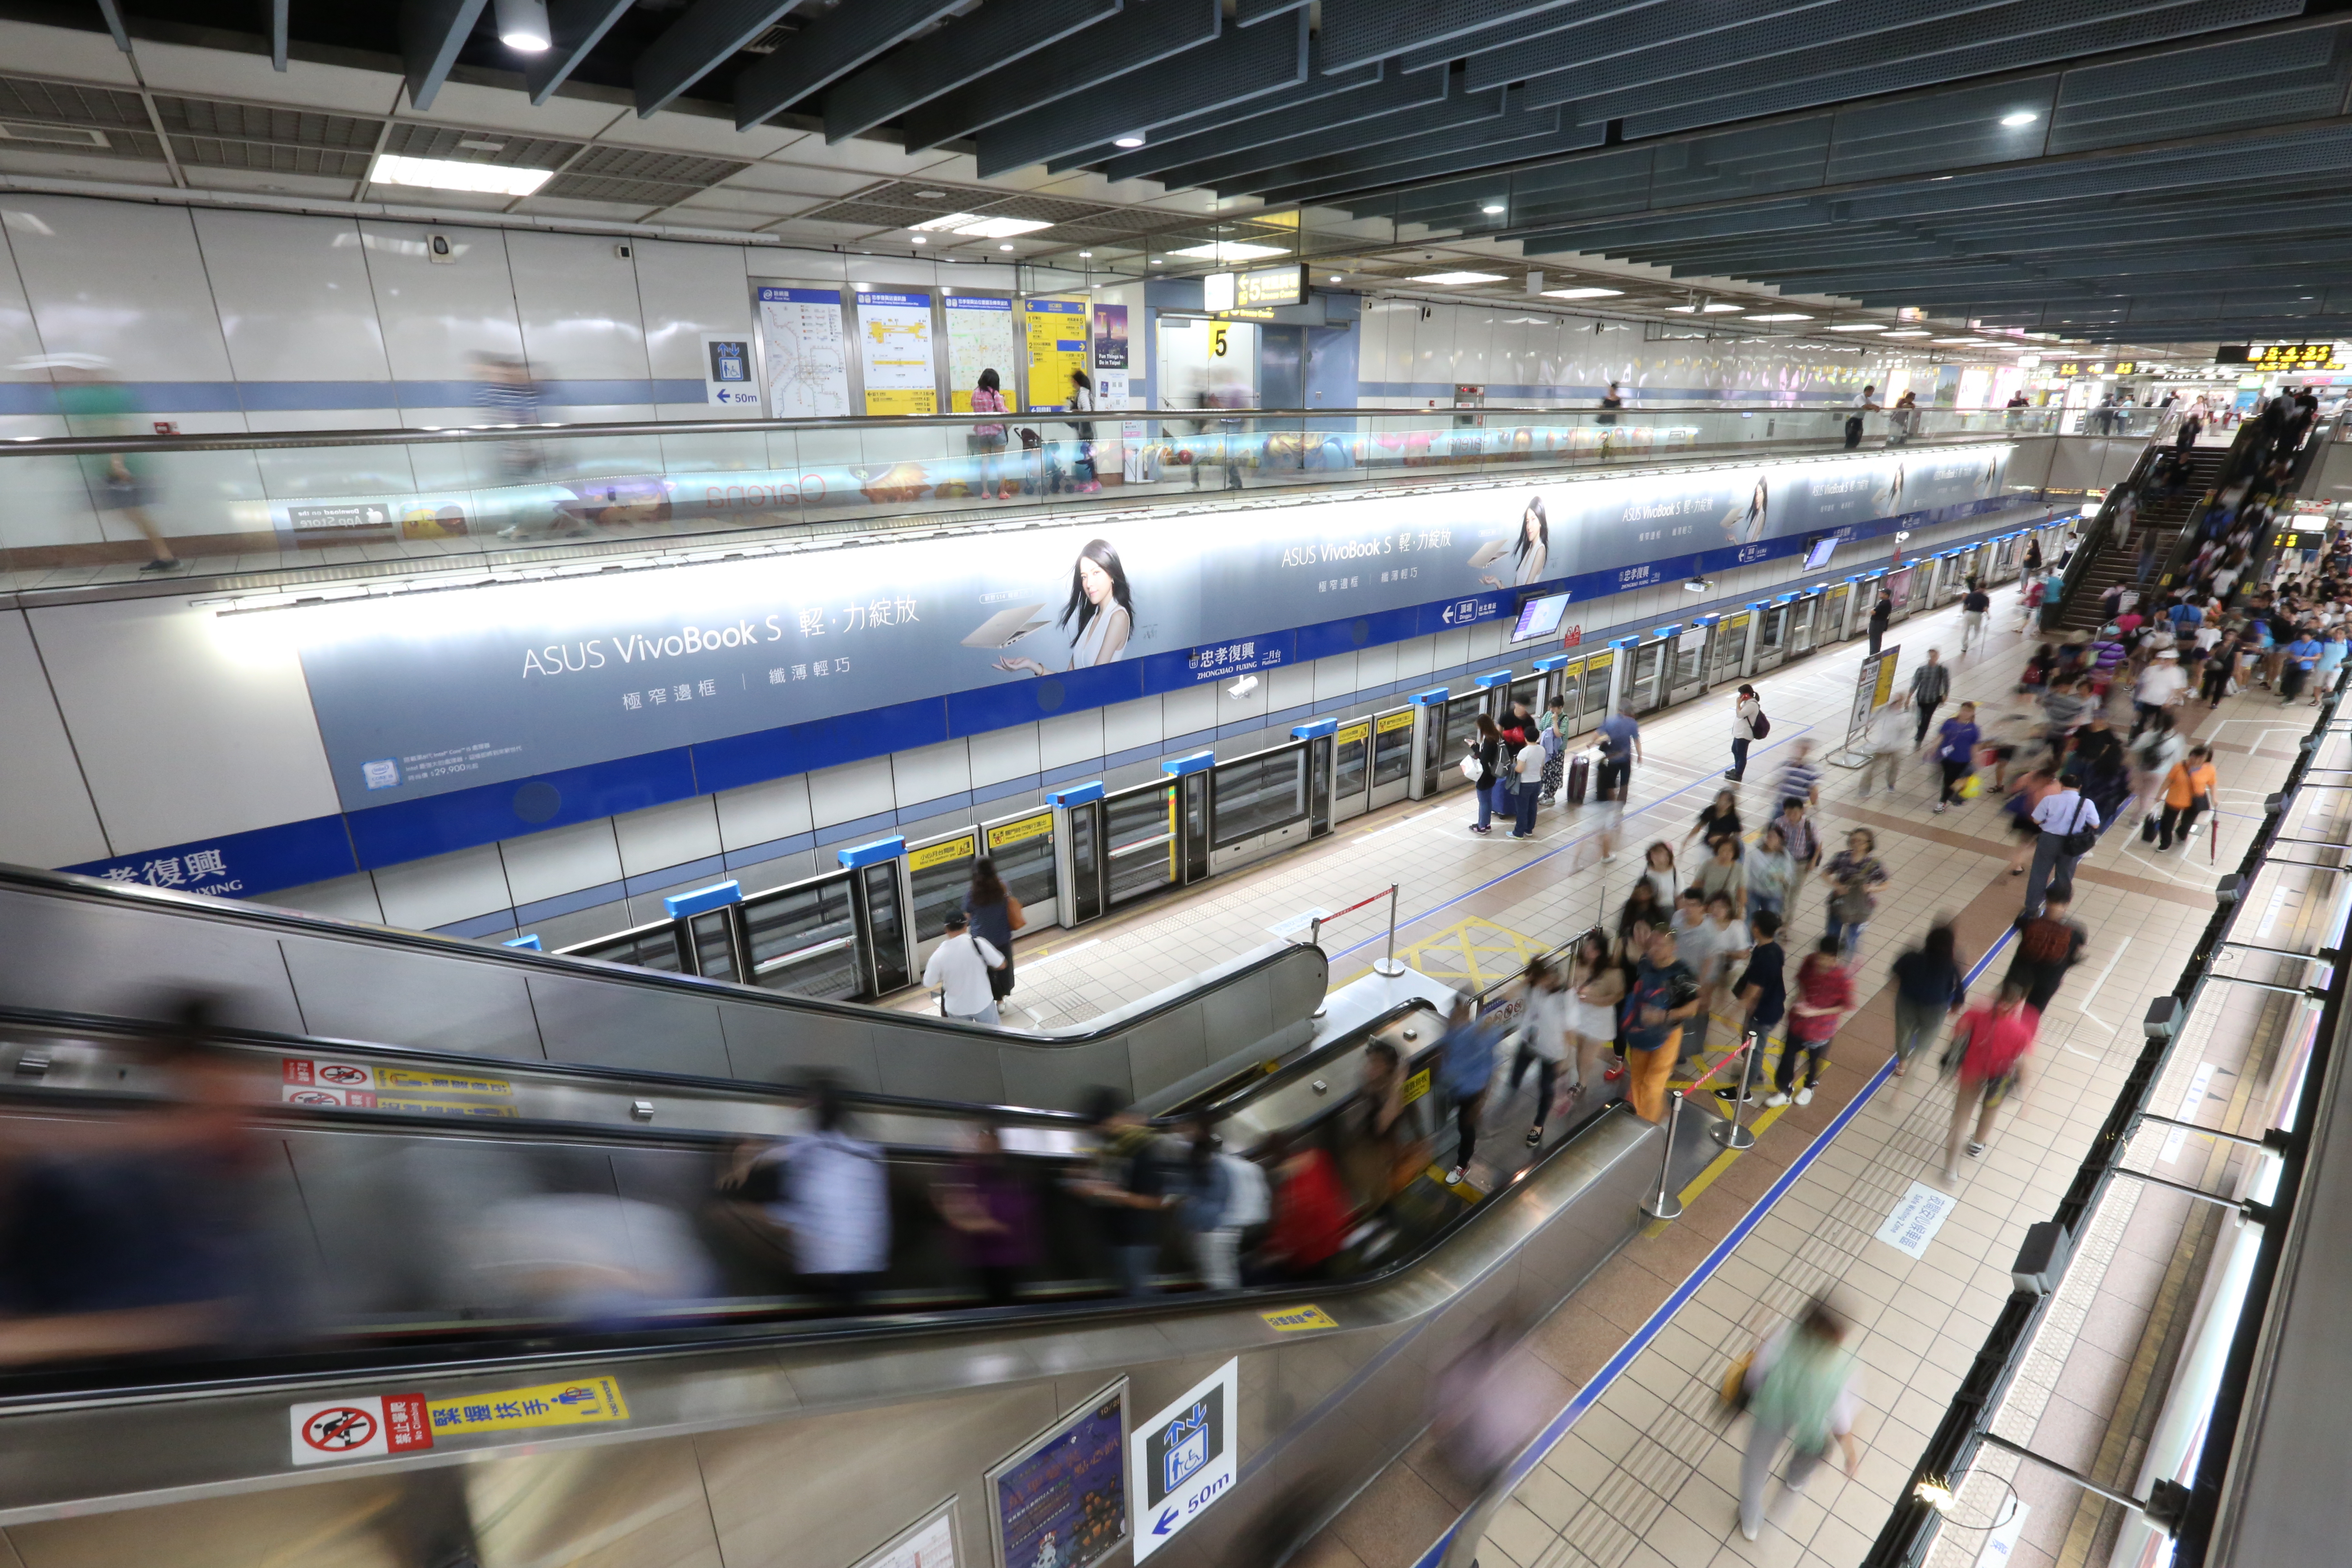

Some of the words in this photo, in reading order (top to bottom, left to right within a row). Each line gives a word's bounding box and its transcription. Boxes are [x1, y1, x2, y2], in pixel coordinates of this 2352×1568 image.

[1249, 278, 1260, 301] 5
[1280, 290, 1299, 298] Center
[1215, 330, 1227, 356] 5
[735, 394, 757, 403] 50m
[1622, 506, 1642, 521] ASUS
[1643, 503, 1675, 519] VivoBook
[1675, 501, 1681, 515] S
[1282, 545, 1316, 568] ASUS
[1320, 537, 1380, 563] VivoBook
[1384, 536, 1391, 554] S
[1319, 575, 1359, 593] 極窄邊框
[1624, 566, 1649, 581] 忠孝復興
[523, 639, 606, 678] ASUS
[613, 619, 757, 664] VivoBook
[765, 615, 782, 641] S
[1200, 642, 1255, 668] 忠孝復興
[1262, 649, 1281, 661] 二月台
[769, 657, 851, 685] 纖薄輕巧
[1197, 666, 1234, 680] ZHONGXIAO
[1236, 661, 1257, 671] FUXING
[623, 679, 715, 710] 極窄邊框
[1032, 955, 1059, 966] Waiting
[1060, 949, 1074, 958] Line
[1911, 1194, 1923, 1205] Safe
[1897, 1204, 1916, 1221] Waiting
[1899, 1195, 1945, 1249] 夜間安心候車區
[1890, 1221, 1904, 1233] Zone
[390, 1401, 411, 1445] 禁止攀爬
[411, 1402, 421, 1429] Climbing
[434, 1399, 550, 1427] 緊握扶手
[415, 1430, 423, 1440] No
[1187, 1472, 1230, 1514] 50m
